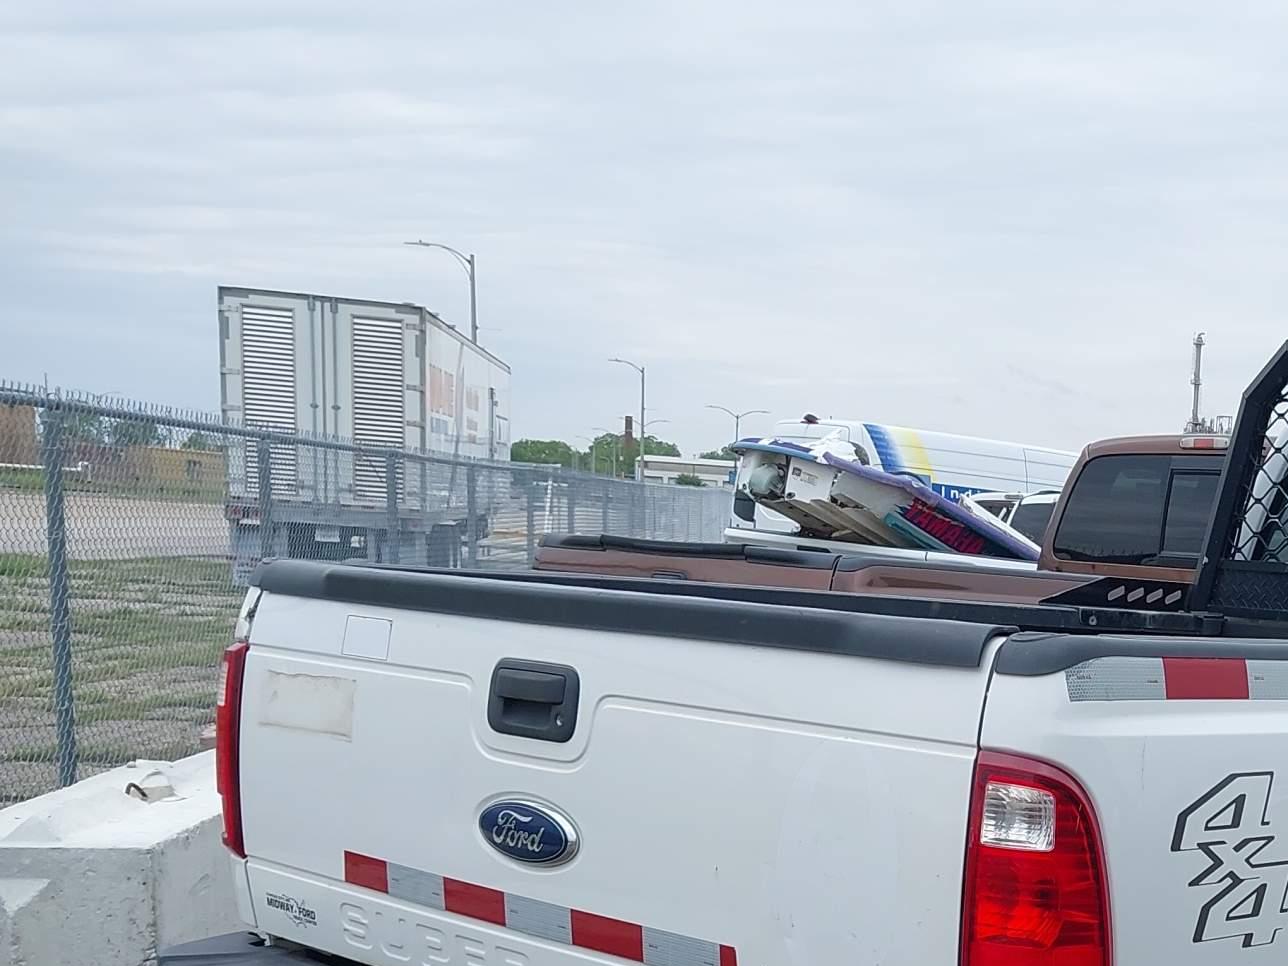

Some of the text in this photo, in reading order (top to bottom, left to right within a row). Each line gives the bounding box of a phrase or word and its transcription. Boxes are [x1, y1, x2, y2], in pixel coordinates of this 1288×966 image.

[941, 486, 980, 499] Ind
[493, 810, 545, 852] Ford
[266, 897, 293, 913] MIDWAY
[298, 907, 316, 920] FORD
